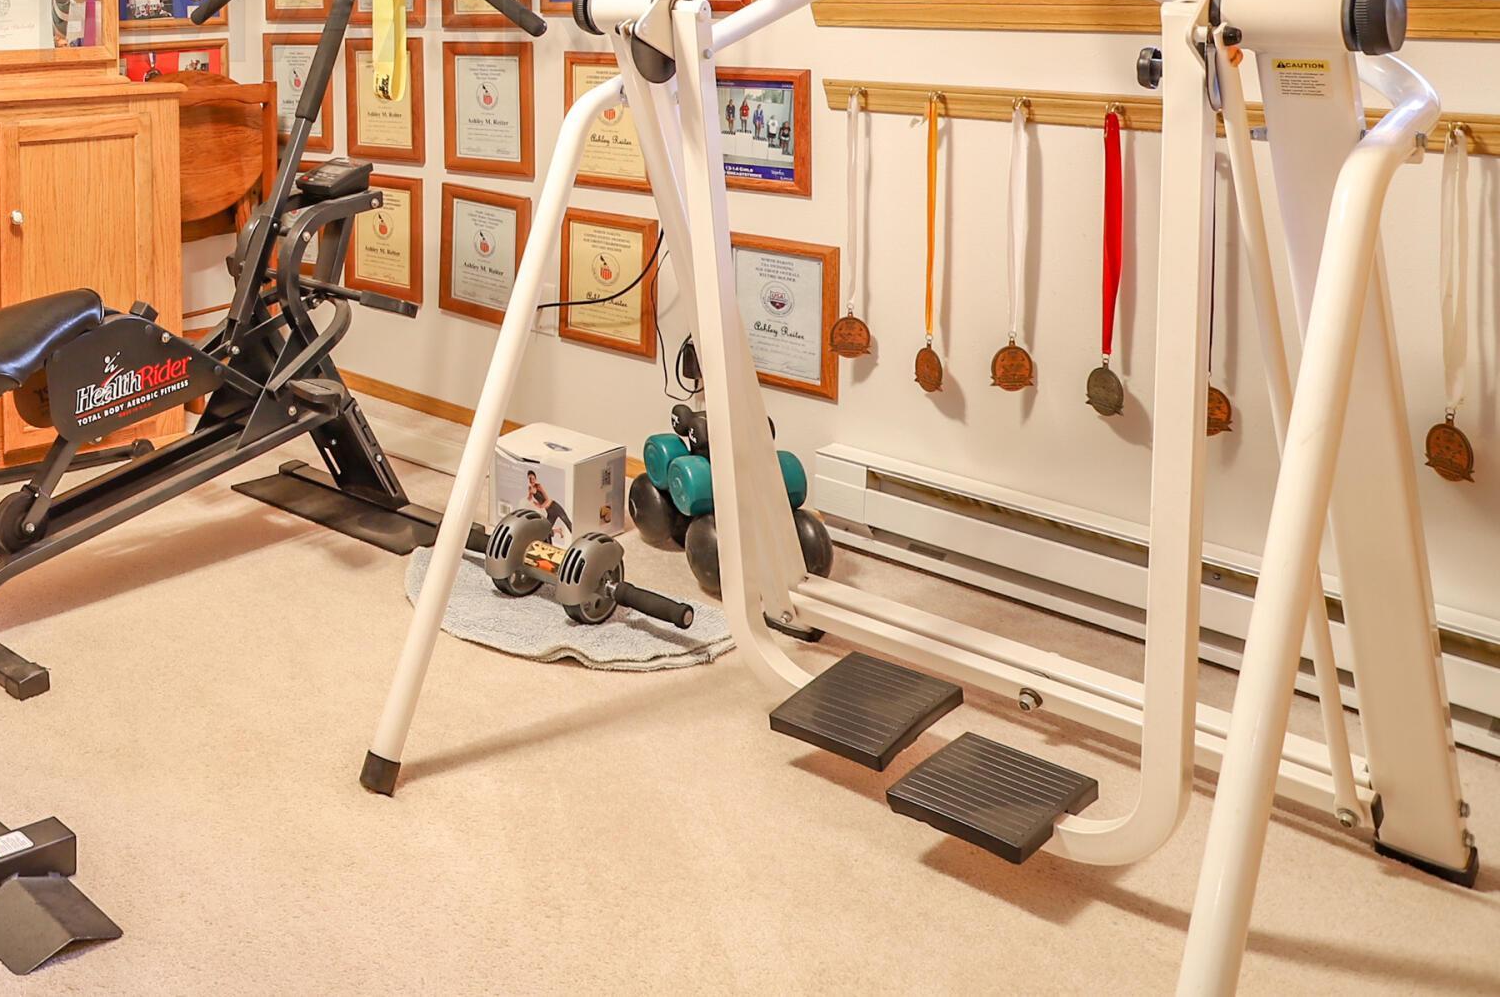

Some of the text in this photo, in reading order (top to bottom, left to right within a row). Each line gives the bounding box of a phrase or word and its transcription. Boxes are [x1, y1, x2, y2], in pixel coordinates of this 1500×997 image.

[467, 118, 484, 126] Ashley
[492, 119, 509, 127] Reiter
[589, 132, 633, 146] Ashley Reiter
[462, 260, 480, 271] Ashley
[488, 266, 504, 277] Reiter
[753, 321, 805, 340] Ashley Reiter
[77, 414, 102, 426] TOTAL
[103, 403, 125, 417] BODY
[127, 391, 159, 408] AEROBIC
[160, 379, 189, 396] FITNESS
